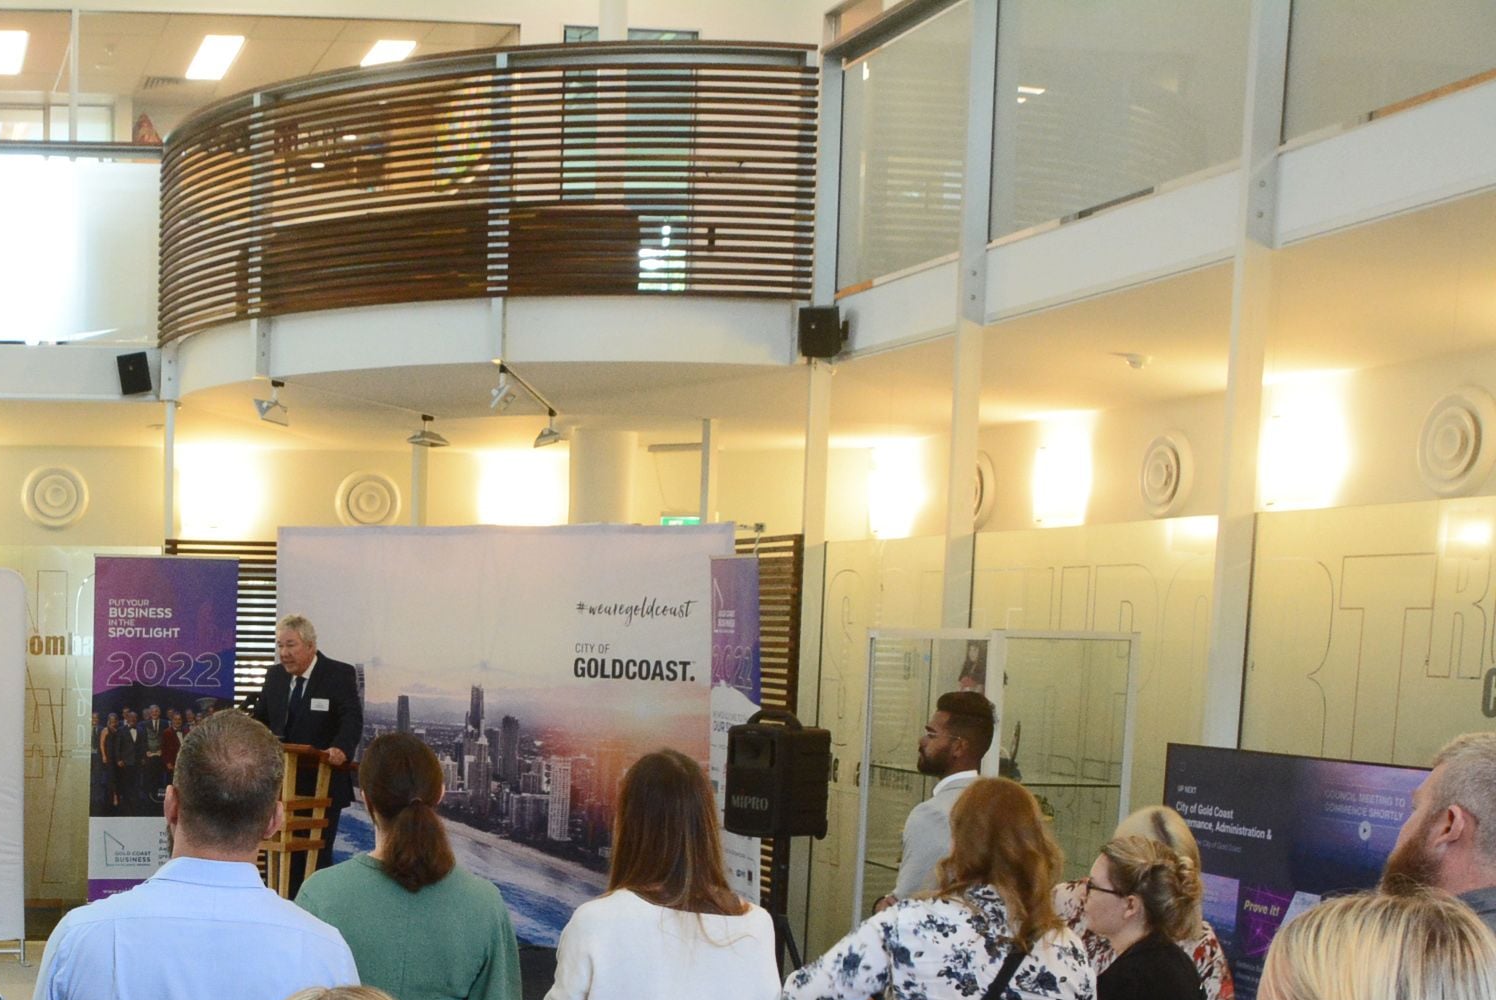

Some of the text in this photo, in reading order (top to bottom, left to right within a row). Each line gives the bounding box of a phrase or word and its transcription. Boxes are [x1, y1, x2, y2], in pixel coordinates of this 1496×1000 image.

[108, 598, 150, 607] PUT YOUR
[108, 607, 173, 619] BUSINESS
[576, 596, 699, 626] #wearegoldcoast
[108, 618, 135, 627] IN THE
[108, 627, 181, 638] SPOTLIGHT
[575, 643, 610, 654] CITY OF
[106, 651, 222, 688] 2022
[573, 657, 696, 683] GOLDCOAST.
[1175, 801, 1234, 819] City of Gold Coast
[1215, 821, 1265, 839] Administration
[1266, 829, 1272, 840] &
[1244, 900, 1268, 915] Prove
